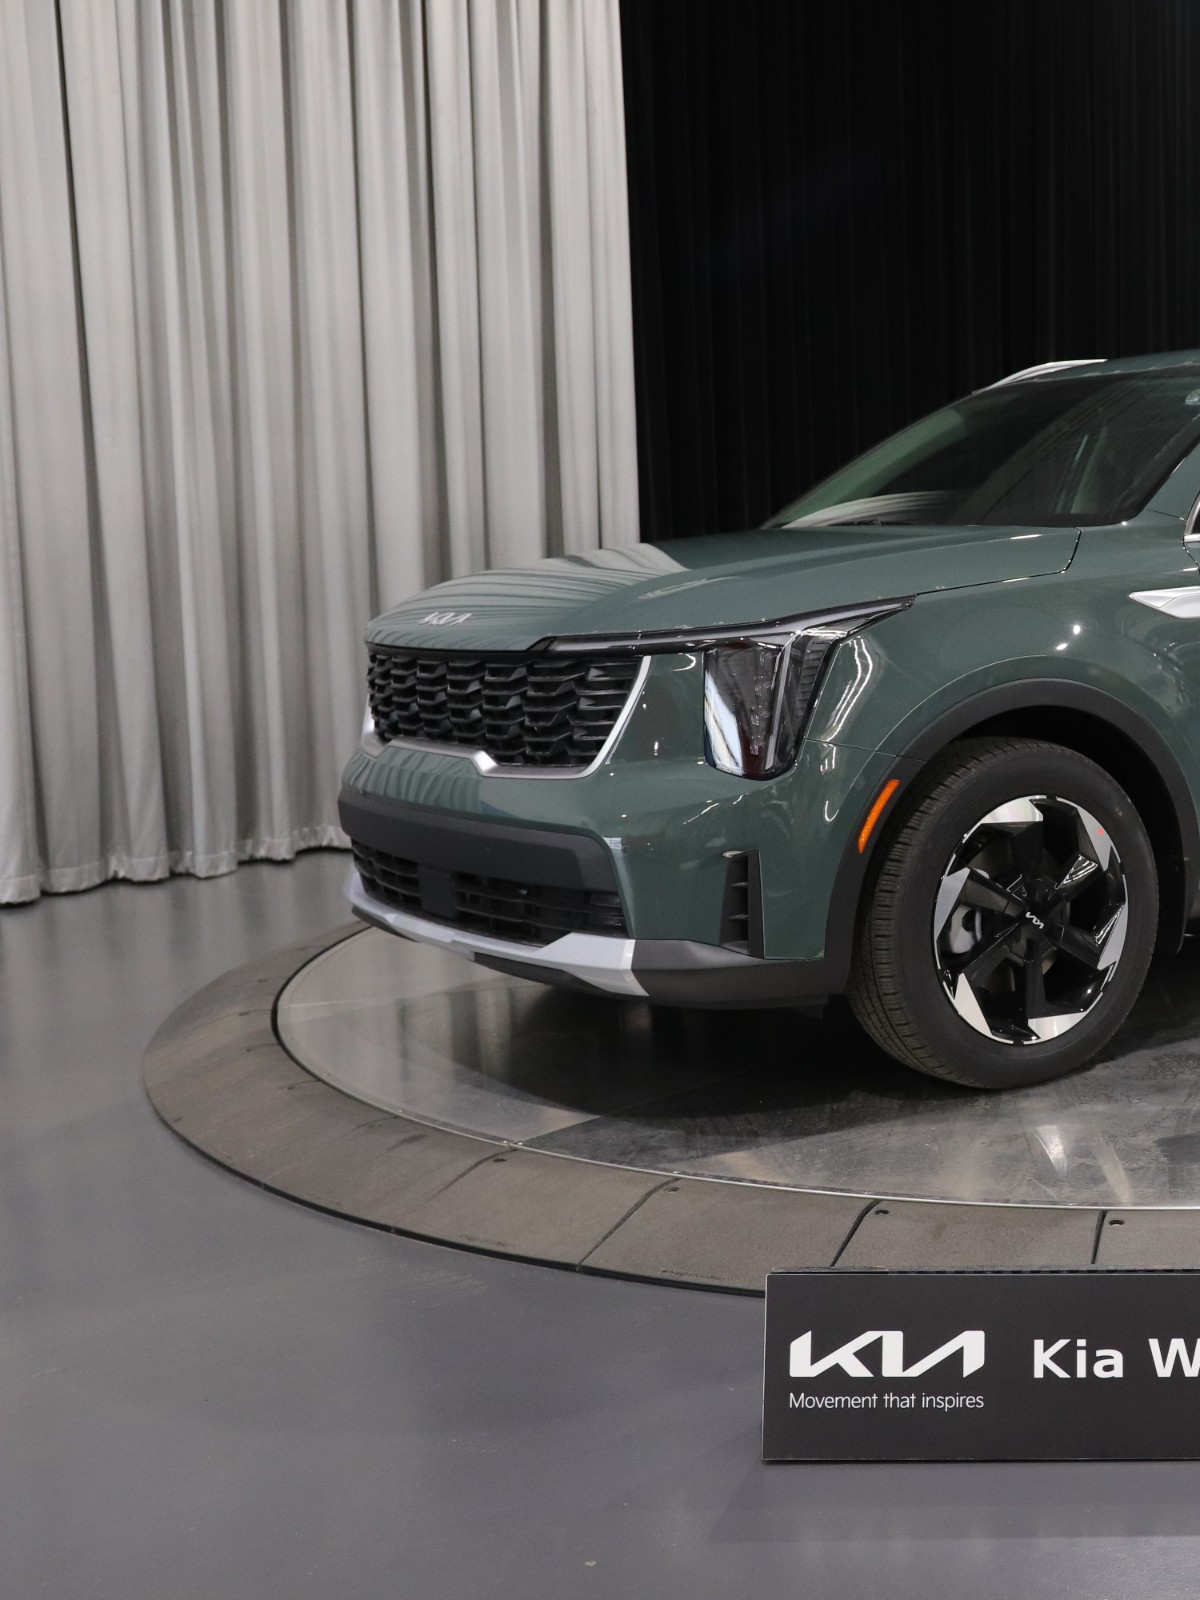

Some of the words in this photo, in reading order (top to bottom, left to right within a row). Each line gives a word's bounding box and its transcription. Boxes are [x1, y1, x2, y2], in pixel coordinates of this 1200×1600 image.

[789, 1330, 986, 1378] KIA
[1033, 1338, 1124, 1379] Kia
[789, 1391, 878, 1409] Movement
[882, 1391, 917, 1409] that
[920, 1391, 985, 1413] inspires
